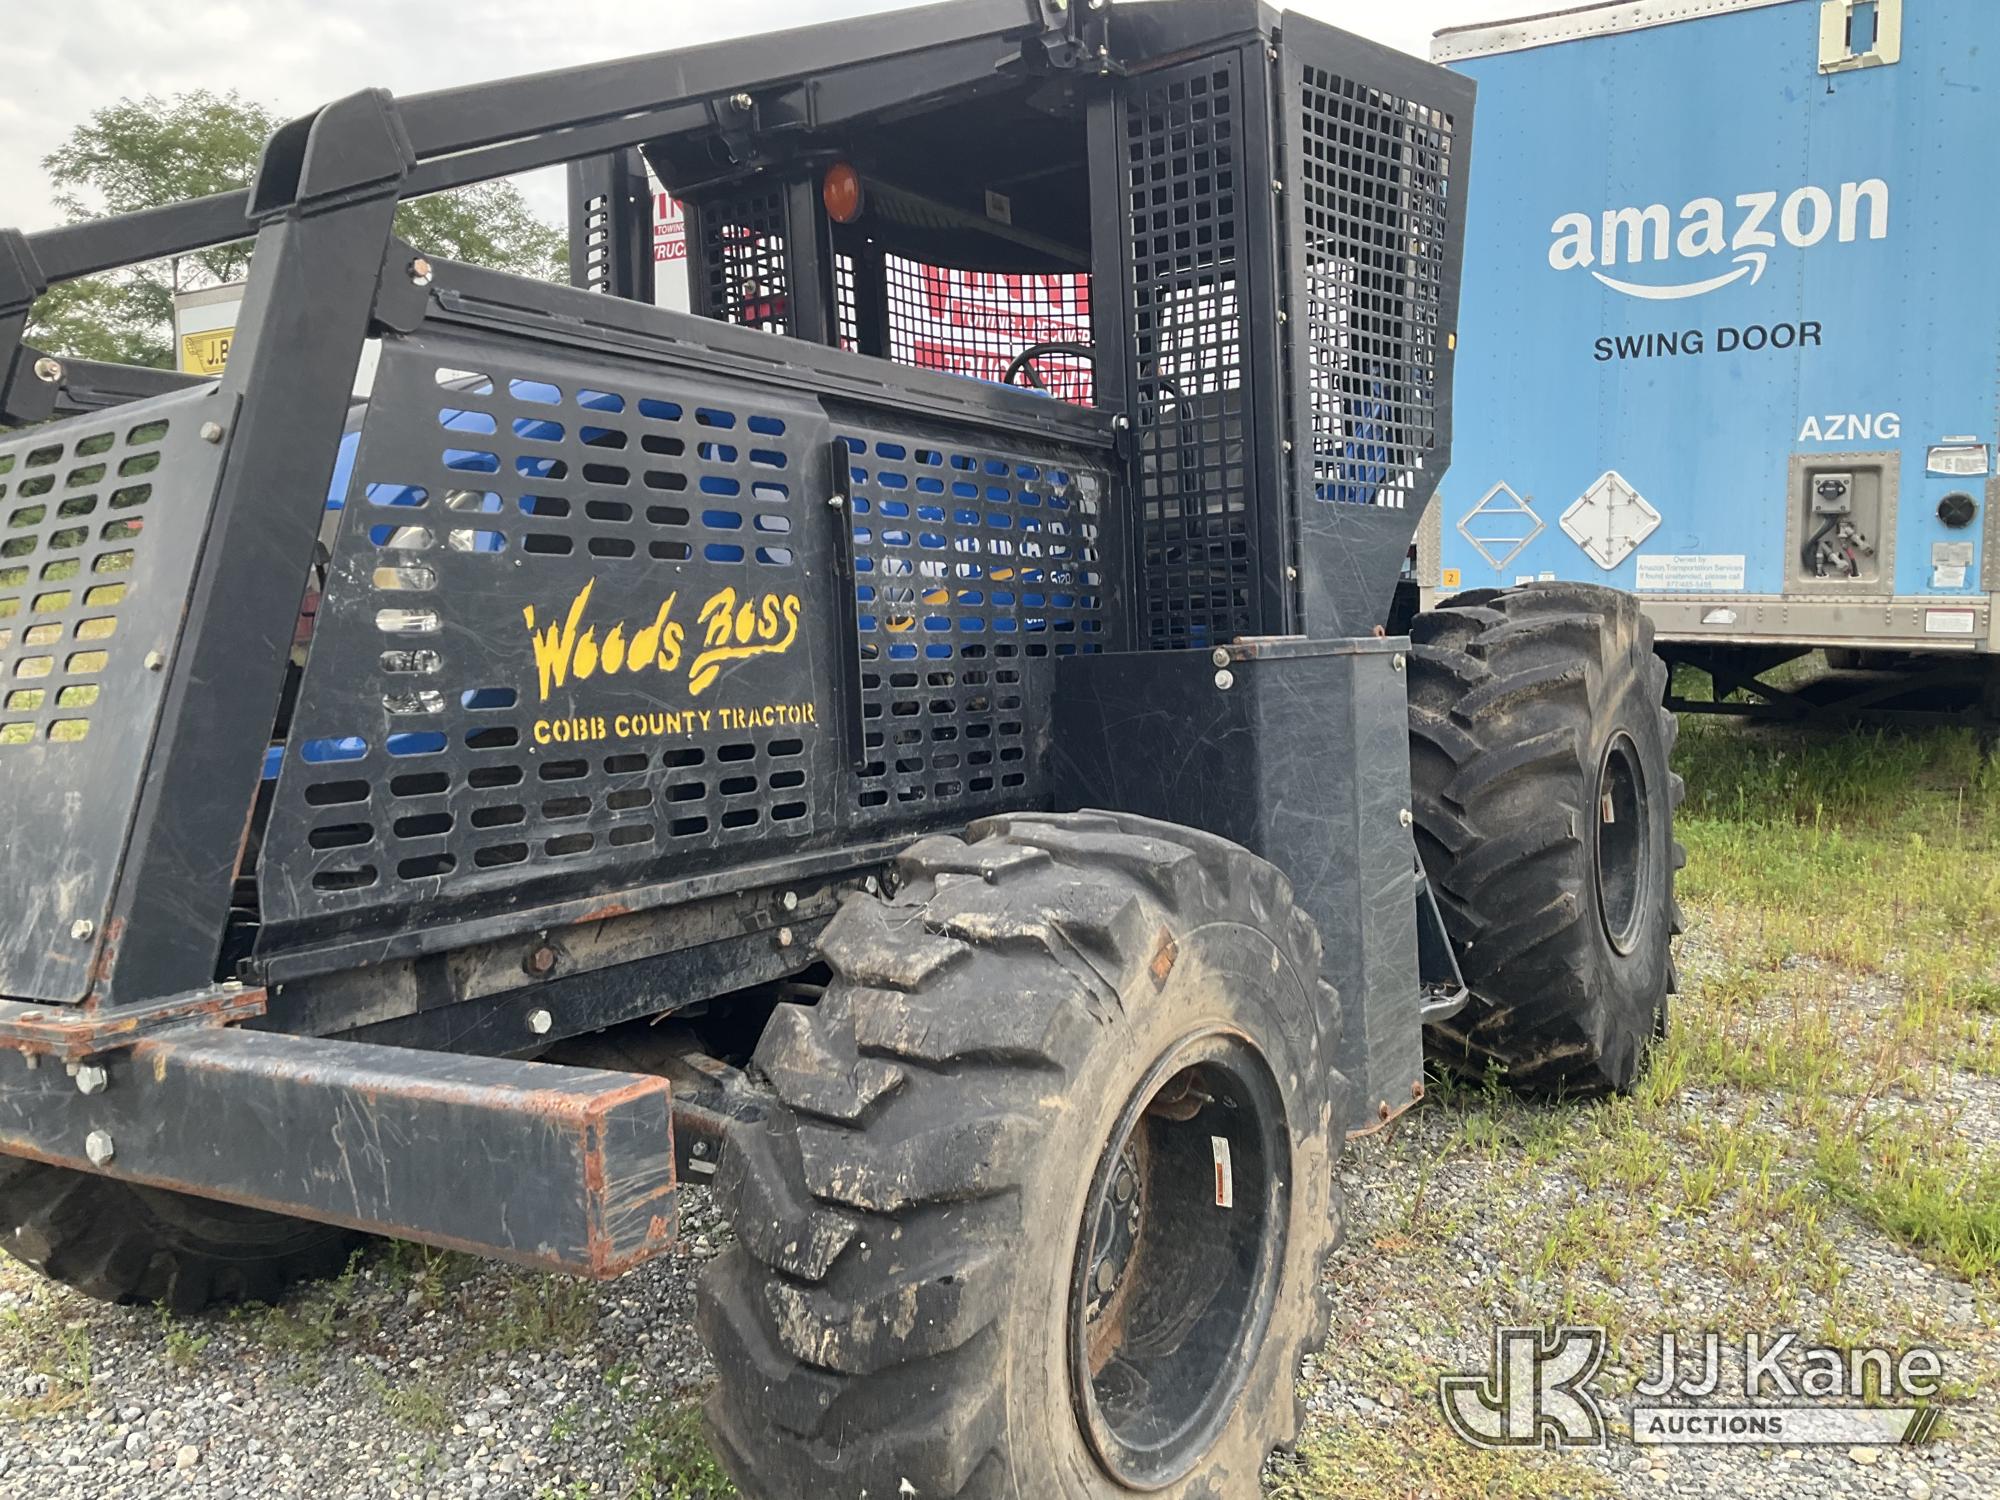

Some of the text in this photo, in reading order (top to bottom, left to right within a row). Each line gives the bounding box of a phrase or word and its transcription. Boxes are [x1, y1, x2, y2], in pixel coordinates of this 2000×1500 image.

[1549, 178, 1889, 271] amazon
[1593, 320, 1823, 362] SWING DOOR
[1798, 412, 1901, 442] AZNG
[523, 575, 800, 702] Woods Boss
[533, 702, 816, 744] COBB COUNTY TRACTOR
